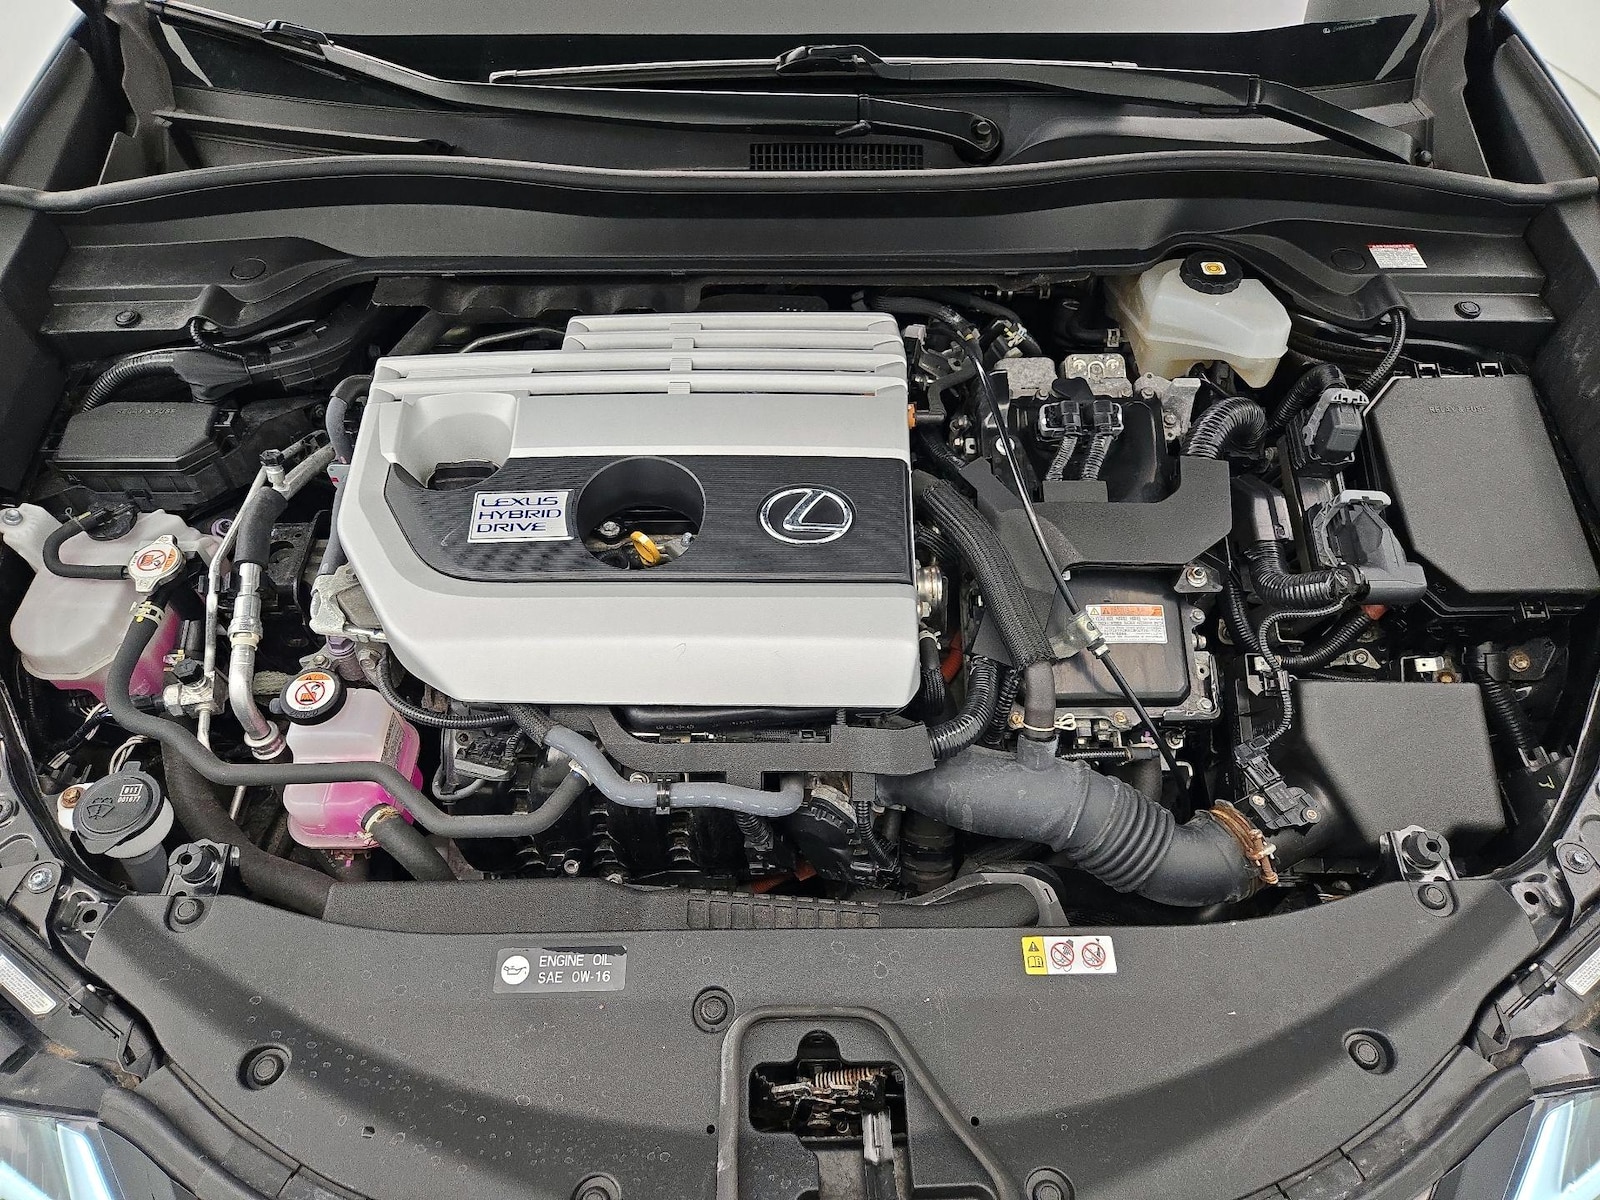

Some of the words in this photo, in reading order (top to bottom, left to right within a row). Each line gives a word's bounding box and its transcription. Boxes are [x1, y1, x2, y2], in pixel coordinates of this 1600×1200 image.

[481, 496, 558, 507] LEXUS
[479, 509, 562, 520] HYBRID
[477, 522, 546, 533] DRIVE
[539, 954, 585, 968] ENGINE
[592, 953, 613, 966] OIL
[537, 971, 564, 984] SAE
[571, 970, 612, 983] 0W-16
